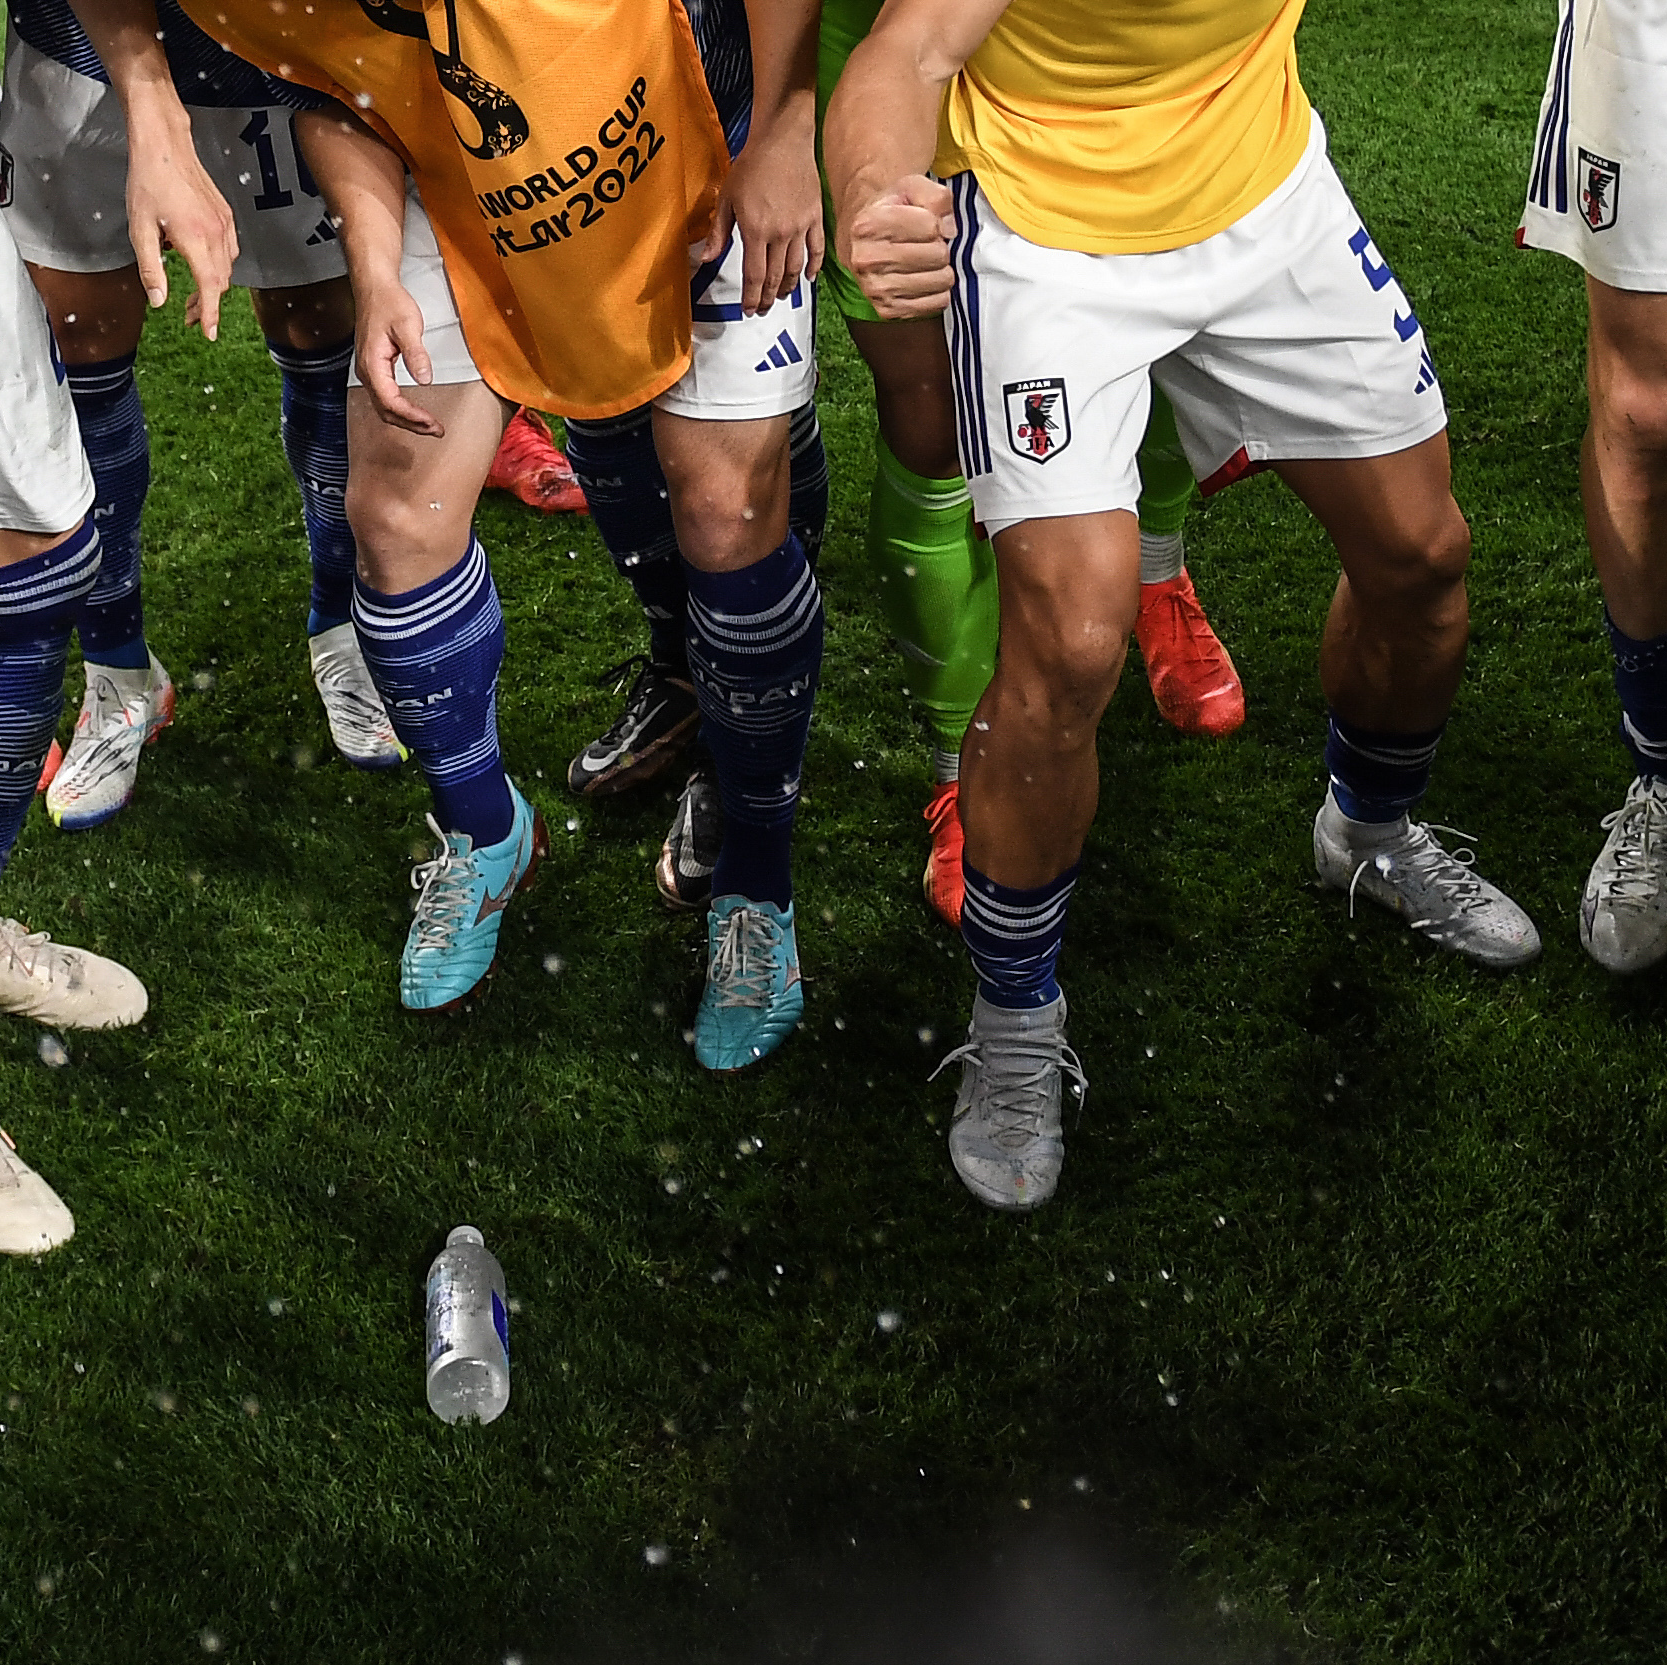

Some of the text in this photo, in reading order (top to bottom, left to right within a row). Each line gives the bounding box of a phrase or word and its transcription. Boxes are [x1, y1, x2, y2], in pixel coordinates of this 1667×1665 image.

[482, 76, 647, 219] WORLD CUP
[1585, 153, 1609, 168] JAPAN
[1016, 380, 1052, 392] JAPAN
[1025, 437, 1056, 453] JFA
